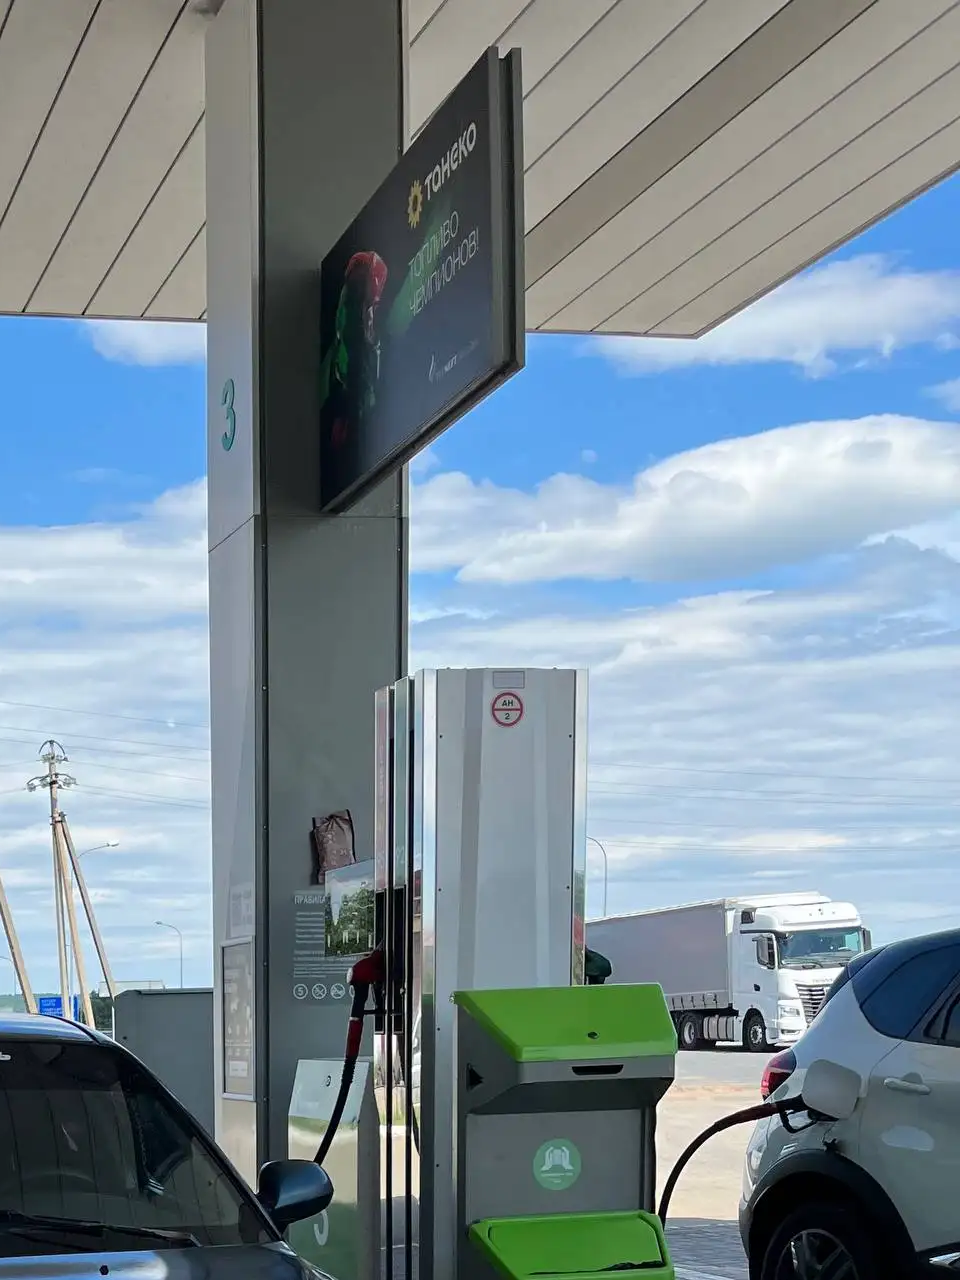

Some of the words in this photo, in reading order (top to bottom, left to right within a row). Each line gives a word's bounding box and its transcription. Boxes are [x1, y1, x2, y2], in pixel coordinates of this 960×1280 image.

[408, 211, 459, 281] ТОПЛИВО
[410, 227, 480, 316] ЧЕМПИОНОВ!
[221, 379, 236, 452] 3
[504, 712, 511, 721] 2
